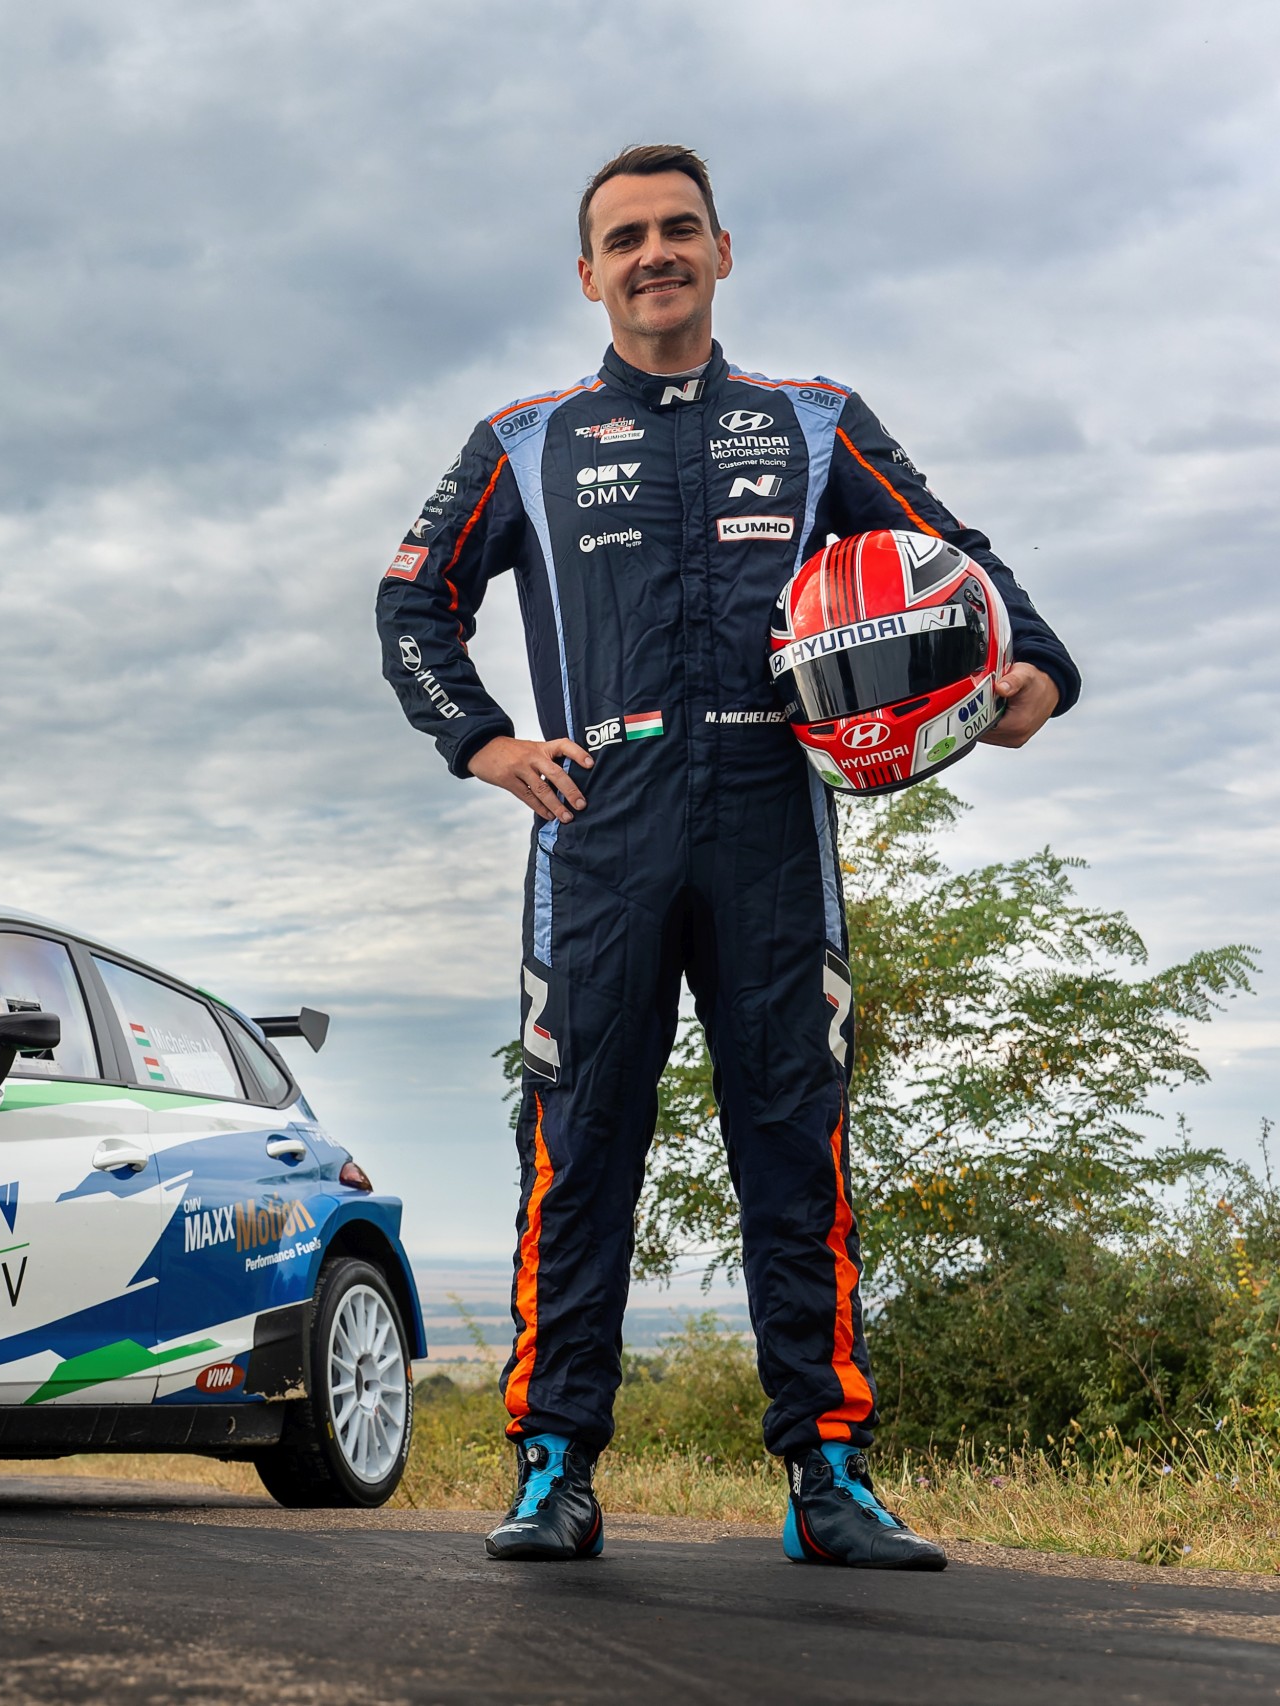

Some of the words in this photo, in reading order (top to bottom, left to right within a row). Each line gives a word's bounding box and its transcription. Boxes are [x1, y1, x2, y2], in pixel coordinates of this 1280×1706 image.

[799, 389, 841, 407] OMP
[500, 411, 538, 435] OMP
[604, 433, 626, 441] KUMHO
[710, 436, 789, 450] HYUNDAI
[711, 448, 790, 460] MOTORSPORT
[719, 459, 757, 469] Customer
[759, 459, 786, 467] Racing
[577, 485, 640, 508] OMV
[597, 528, 642, 545] simple
[723, 522, 790, 534] KUMHO
[394, 554, 415, 565] BRC
[791, 616, 907, 664] HYUNDAI
[964, 708, 990, 740] OMV
[586, 722, 620, 746] OMP
[840, 744, 910, 769] HYUNDAI
[184, 1197, 201, 1214] OMV
[245, 1248, 296, 1272] Performance
[295, 1237, 321, 1256] Fuels
[206, 1367, 234, 1388] VIVA
